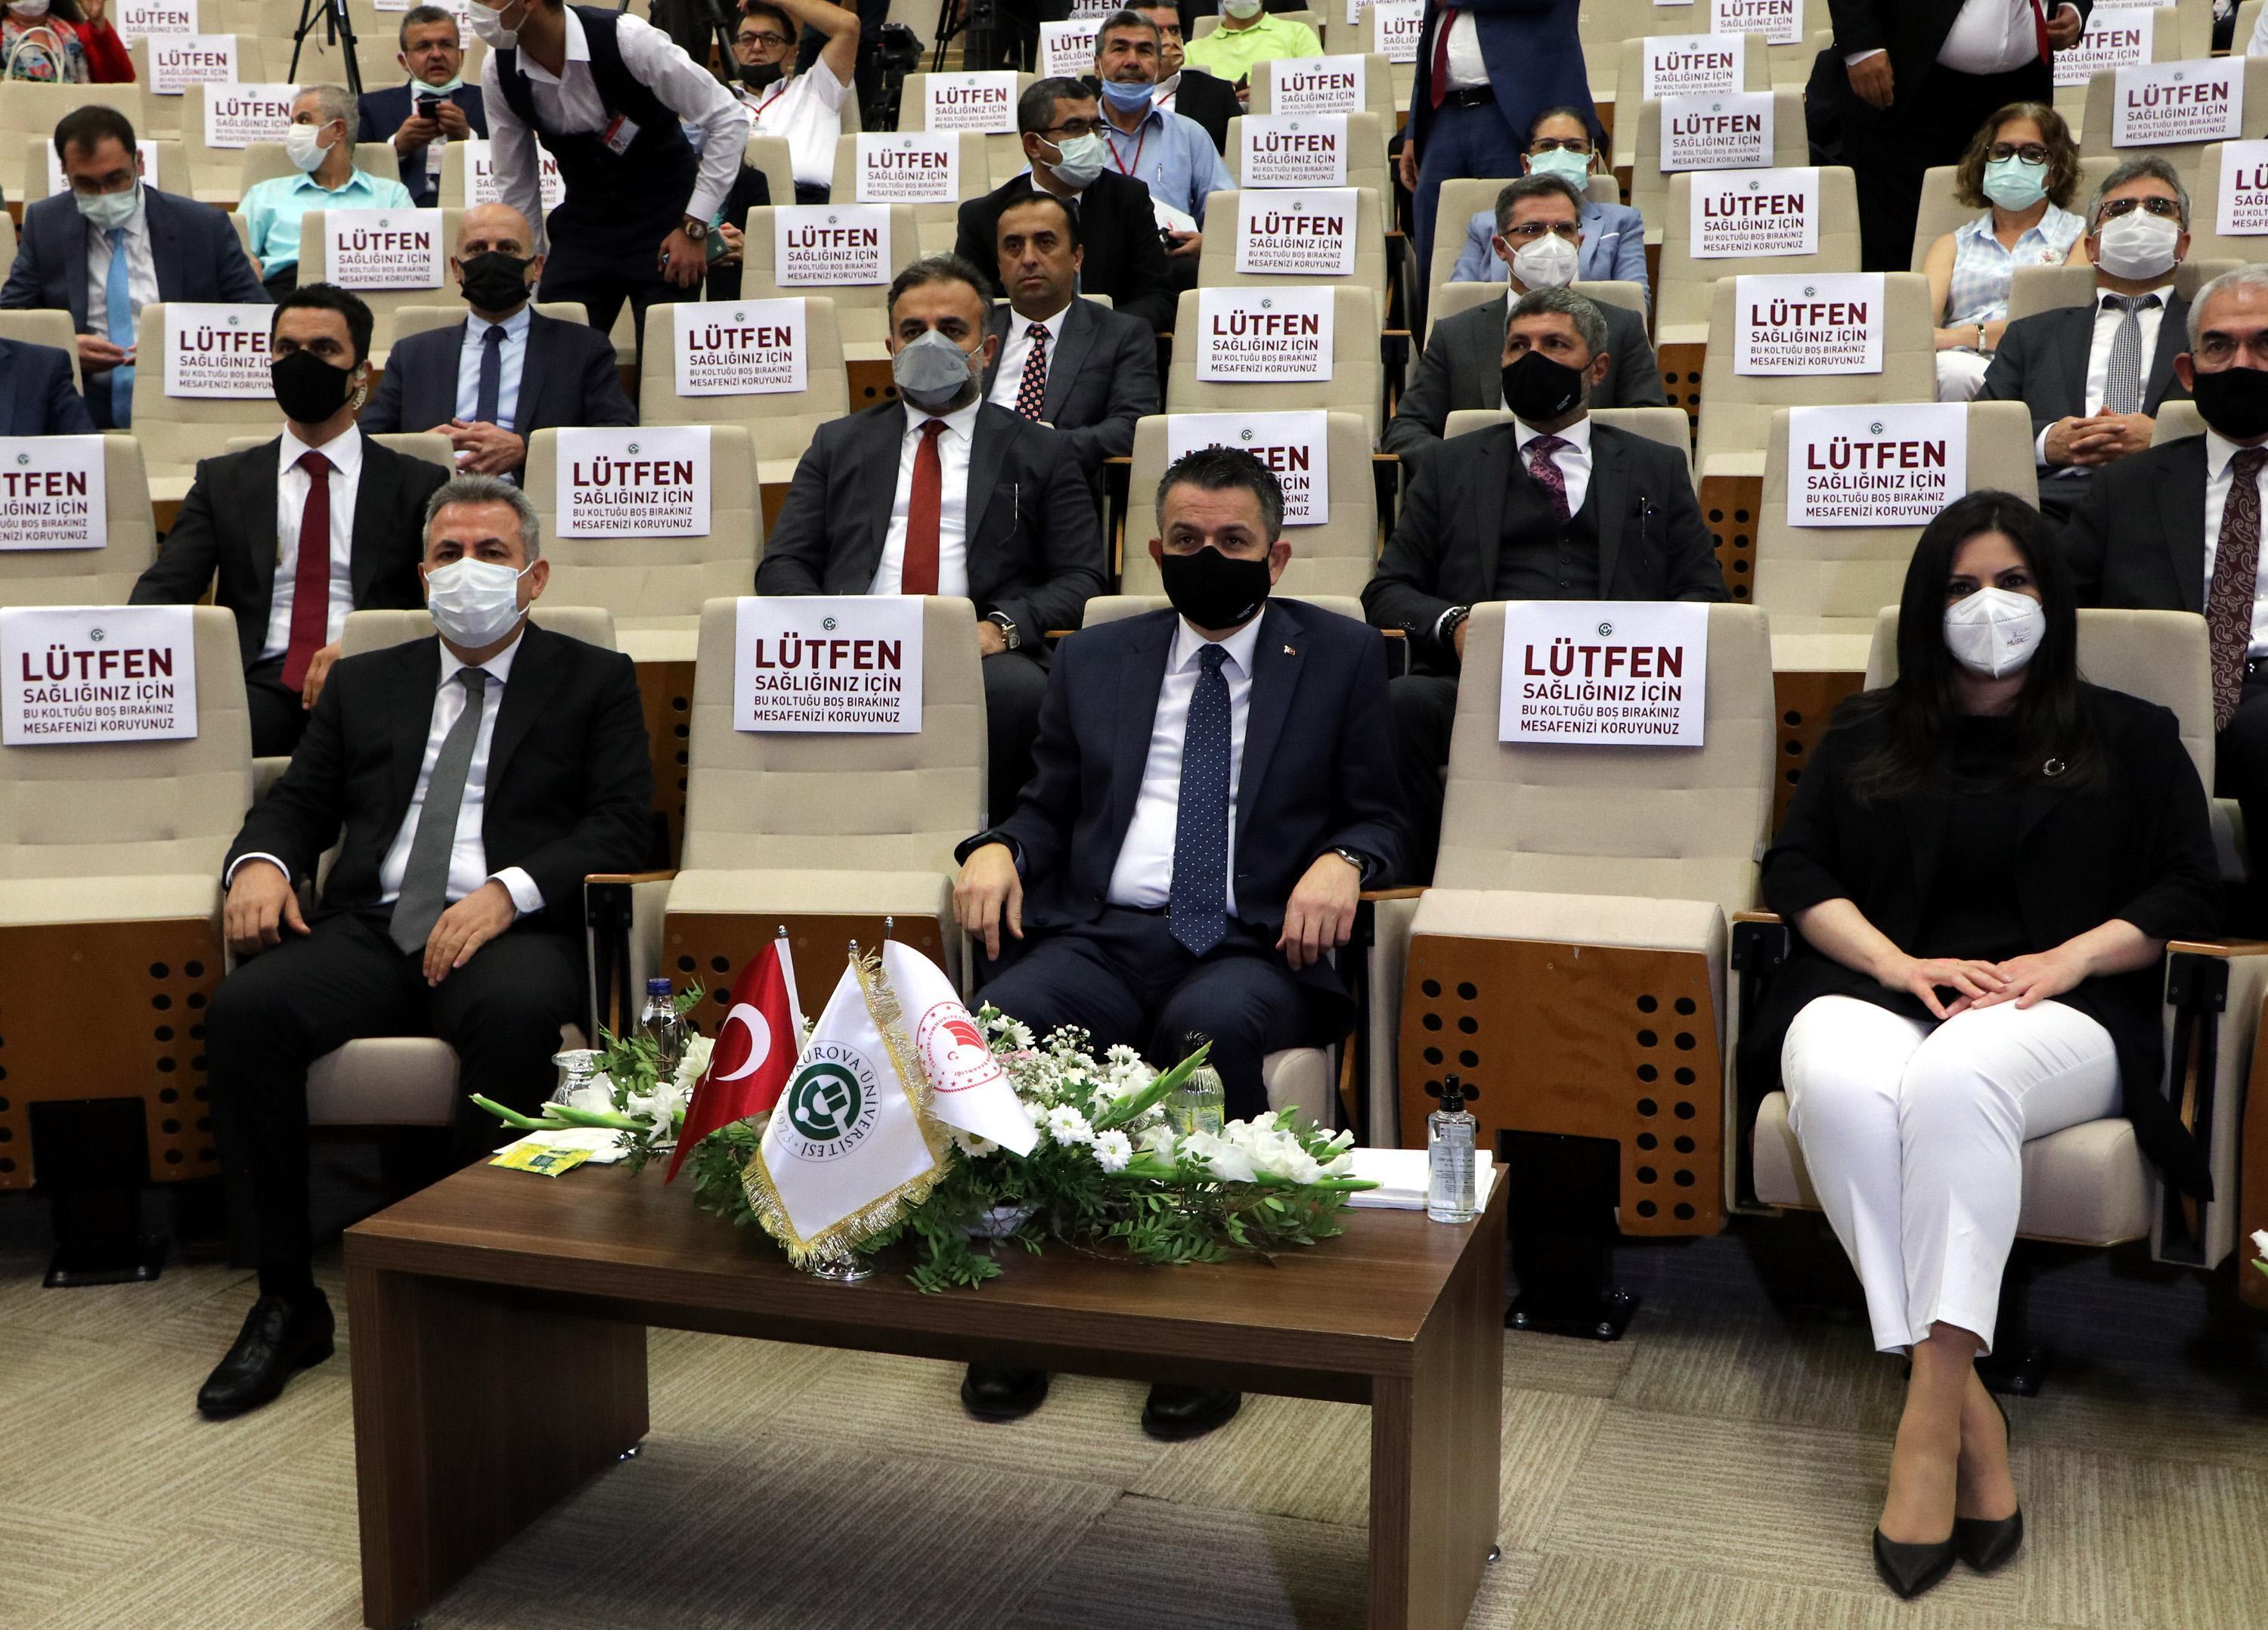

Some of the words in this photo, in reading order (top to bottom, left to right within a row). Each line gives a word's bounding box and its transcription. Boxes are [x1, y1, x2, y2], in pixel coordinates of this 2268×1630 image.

[125, 8, 188, 23] LÜTFEN
[1051, 34, 1098, 51] LÜTF
[2068, 29, 2140, 50] TFEN
[158, 49, 227, 66] LÜTFEN
[1655, 51, 1733, 71] LÜTFEN
[1281, 73, 1355, 91] LÜTFEN
[1655, 71, 1710, 82] SAĞLIĞINIZ
[1713, 70, 1733, 82] İÇİN
[935, 87, 1007, 104] LÜTFEN
[1281, 91, 1334, 103] SAĞLIĞINIZ
[1336, 89, 1355, 101] İÇİN
[2128, 82, 2228, 108] LÜTFEN
[215, 98, 290, 116] LÜTFEN
[2127, 107, 2198, 121] SAĞLIĞINIZ
[2201, 102, 2227, 117] İÇİN
[1673, 113, 1761, 135] LÜTFEN
[2177, 126, 2226, 135] KORUYUNUZ
[1253, 132, 1335, 151] LÜTFEN
[1673, 135, 1735, 147] SAĞLIĞINIZ
[1738, 133, 1761, 147] İÇİN
[868, 149, 947, 168] LÜTFEN
[1253, 153, 1311, 163] SAĞLIĞINIZ
[1315, 153, 1335, 165] İÇİN
[868, 169, 924, 180] SAĞLIĞINIZ
[928, 169, 947, 181] İÇİN
[1704, 192, 1804, 217] LÜTFEN
[1250, 212, 1343, 234] LÜTFEN
[1705, 218, 1774, 231] SAĞLIĞINIZ
[1779, 215, 1804, 231] İÇİN
[338, 229, 430, 250] LÜTFEN
[788, 225, 877, 247] LÜTFEN
[1250, 236, 1315, 249] SAĞLIĞINIZ
[1318, 237, 1342, 251] İÇİN
[1716, 232, 1749, 240] KOLTUĞU
[1704, 241, 1752, 251] MESAFENİZİ
[1754, 240, 1803, 249] KORUYUNUZ
[339, 252, 404, 264] SAĞLIĞINIZ
[407, 252, 431, 265] İÇİN
[789, 249, 852, 261] SAĞLIĞINIZ
[855, 248, 878, 262] İÇİN
[1248, 259, 1293, 267] MESAFENİZİ
[788, 271, 832, 279] MESAFENİZİ
[1752, 299, 1867, 326] LÜTFEN
[1213, 310, 1318, 335] LÜTFEN
[181, 327, 273, 352] LÜTFE
[689, 324, 792, 350] LÜTFEN
[1752, 328, 1833, 343] SAĞLIĞINIZ
[1838, 327, 1867, 345] İÇİN
[1213, 337, 1287, 351] SAĞLIĞINIZ
[1292, 337, 1318, 353] İÇİN
[1765, 345, 1803, 354] KOLTUĞU
[1805, 346, 1821, 355] BOŞ
[180, 354, 255, 367] SAĞLIĞINIZ
[690, 351, 763, 366] SAĞLIĞINIZ
[767, 349, 792, 365] İÇİN
[1225, 353, 1260, 361] KOLTUĞU
[1262, 355, 1277, 363] BOŞ
[1751, 355, 1806, 365] MESAFENİZİ
[1809, 356, 1866, 364] KORUYUNUZ
[702, 366, 736, 376] KOLTUĞU
[739, 367, 753, 376] BOŞ
[755, 365, 792, 374] BIRAKINIZ
[1212, 363, 1263, 372] MESAFENİZİ
[690, 376, 740, 386] MESAFENİZİ
[742, 375, 792, 385] KORUYUNUZ
[1808, 436, 1945, 469] LÜTFEN
[573, 456, 692, 486] LÜTFEN
[3, 471, 86, 497] TFEN
[1278, 475, 1309, 493] İÇİN
[1808, 472, 1905, 490] SAĞLIĞINIZ
[1910, 470, 1945, 491] İÇİN
[574, 488, 658, 504] SAĞLIĞINIZ
[663, 488, 693, 506] İÇİN
[1807, 494, 1820, 504] BU
[1823, 491, 1869, 503] KOLTUĞU
[1872, 494, 1892, 504] BOŞ
[1894, 492, 1944, 502] BIRAKINIZ
[0, 500, 51, 515] IĞINIZ
[56, 499, 88, 518] İÇİN
[573, 509, 585, 517] BU
[587, 507, 628, 516] KOLTUĞU
[631, 508, 647, 518] BOŞ
[649, 507, 692, 516] BIRAKINIZ
[1807, 504, 1873, 516] MESAFENİZİ
[1876, 505, 1944, 516] KORUYUNUZ
[21, 519, 39, 529] BOŞ
[42, 519, 87, 527] BIRAKINIZ
[573, 518, 631, 529] MESAFENİZİ
[634, 519, 692, 528] KORUYUNUZ
[26, 531, 88, 541] KORUYUNUZ
[756, 632, 901, 669] LÜTFEN
[1525, 637, 1683, 677] LÜTFEN
[21, 644, 173, 681] LÜTFEN
[23, 683, 131, 704] SAĞLIĞINIZ
[136, 680, 175, 703] İÇİN
[756, 671, 859, 692] SAĞLIĞINIZ
[865, 673, 901, 696] İÇİN
[1524, 680, 1636, 702] SAĞLIĞINIZ
[1642, 681, 1682, 705] İÇİN
[754, 696, 769, 705] BU
[773, 694, 821, 706] KOLTUĞU
[824, 697, 844, 709] BOŞ
[847, 697, 900, 707] BIRAKINIZ
[23, 708, 39, 719] BU
[42, 705, 93, 718] KOLTUĞU
[95, 706, 117, 718] BOŞ
[119, 704, 175, 716] BIRAKINIZ
[754, 708, 825, 721] MESAFENİZİ
[829, 711, 900, 722] KORUYUNUZ
[1522, 705, 1538, 715] BU
[1541, 704, 1594, 717] KOLTUĞU
[1597, 706, 1619, 720] BOŞ
[1622, 708, 1681, 717] BIRAKINIZ
[24, 718, 98, 734] MESAFENİZİ
[101, 717, 175, 731] KORUYUNUZ
[1521, 719, 1597, 733] MESAFENİZİ
[1601, 722, 1680, 734] KORUYUNUZ
